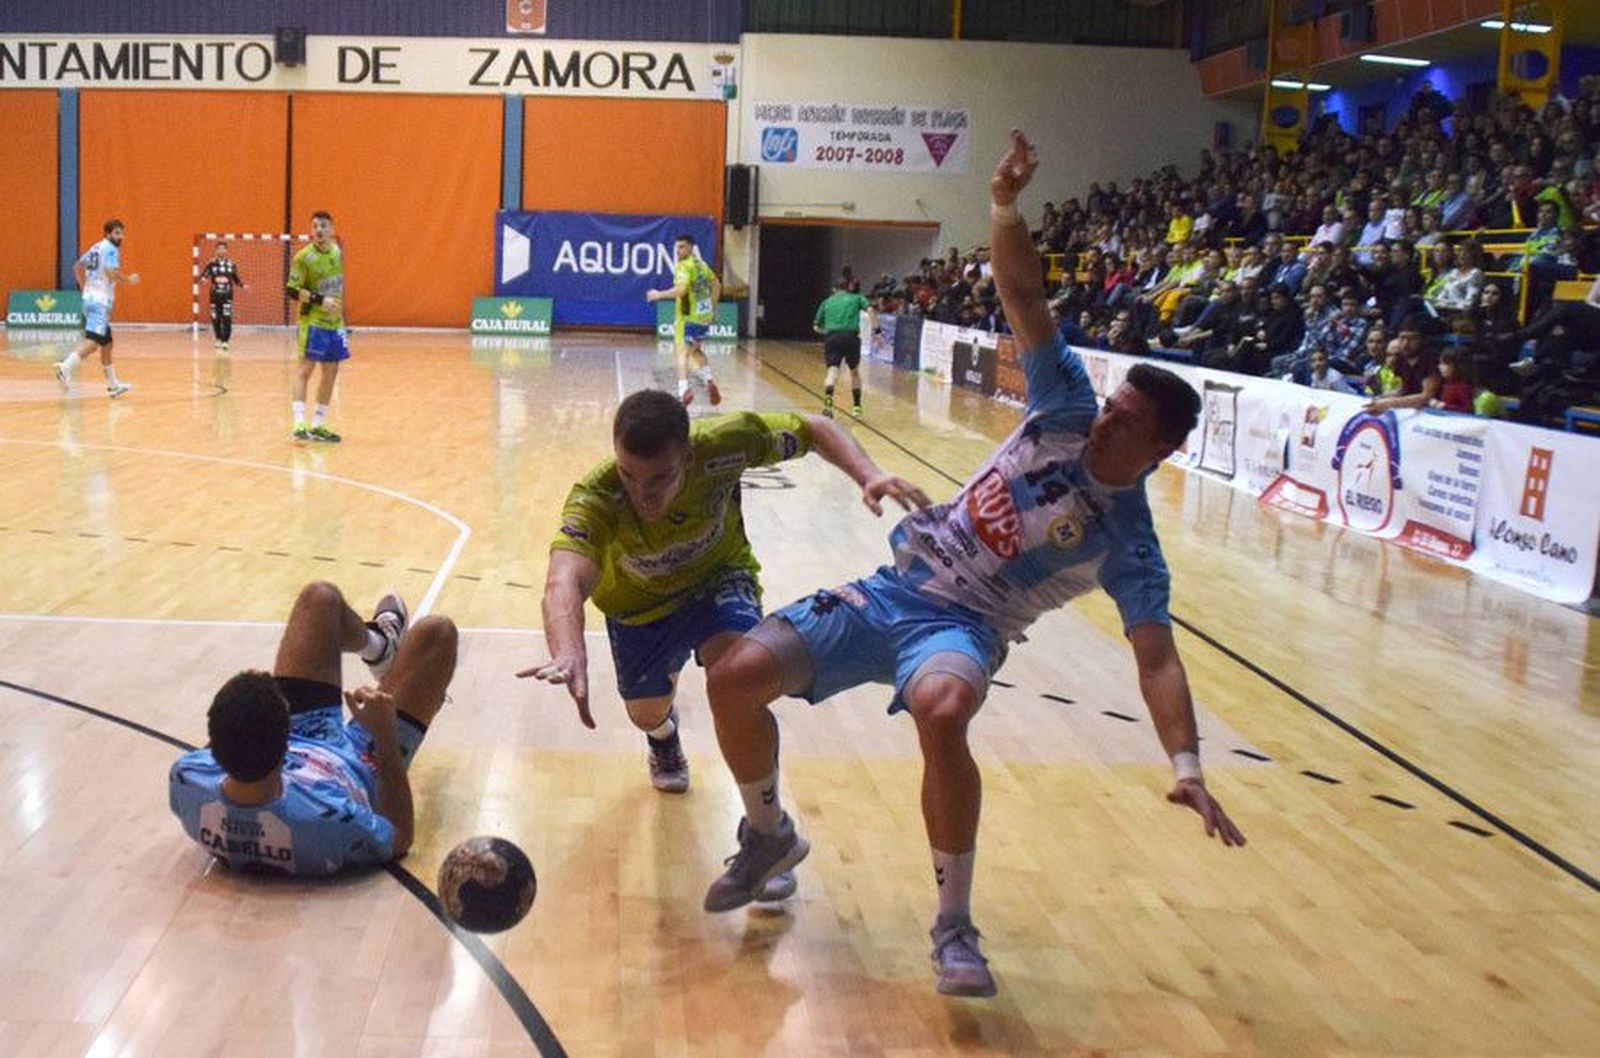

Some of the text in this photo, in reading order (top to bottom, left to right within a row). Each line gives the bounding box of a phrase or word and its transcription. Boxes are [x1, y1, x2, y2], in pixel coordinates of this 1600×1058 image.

[337, 45, 401, 84] DE
[469, 48, 696, 92] ZAMORA
[831, 131, 891, 143] TEMPORADA
[815, 145, 904, 166] 2007-2008
[504, 319, 550, 332] RURAL
